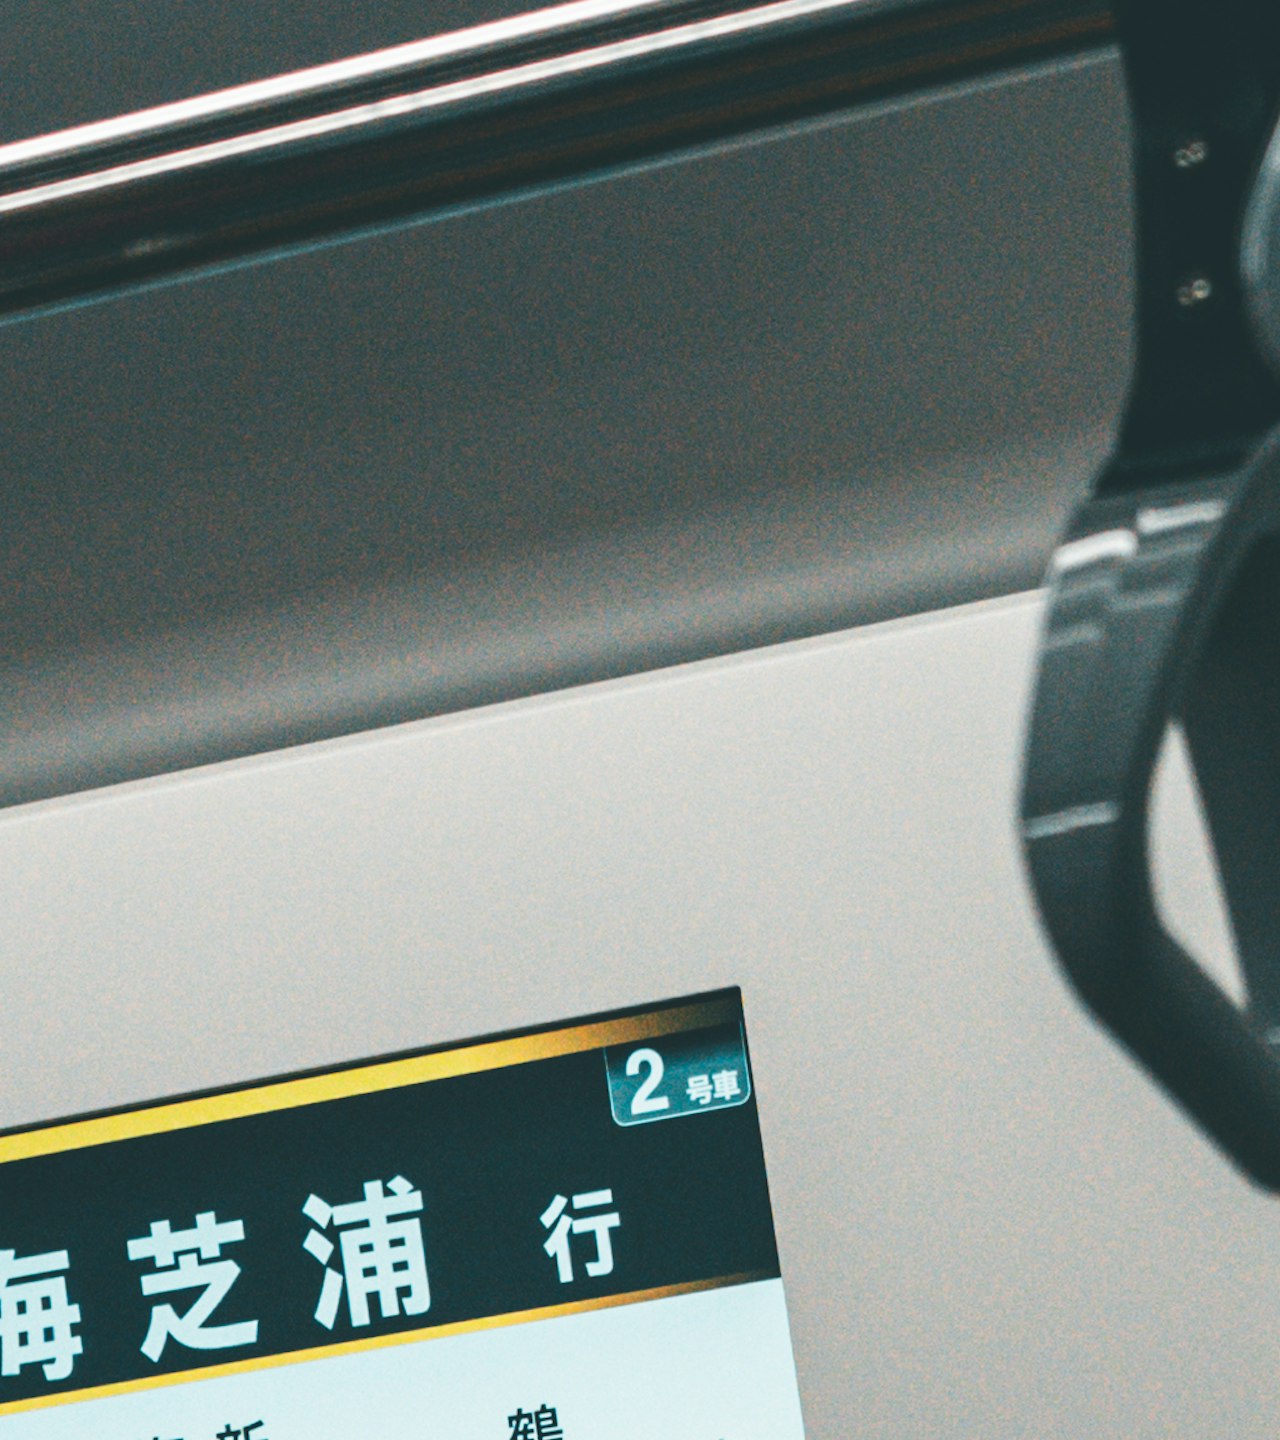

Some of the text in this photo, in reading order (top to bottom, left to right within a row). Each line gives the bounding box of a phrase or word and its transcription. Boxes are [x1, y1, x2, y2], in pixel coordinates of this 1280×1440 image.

[627, 1048, 742, 1116] 2 号車
[540, 1188, 622, 1284] 行
